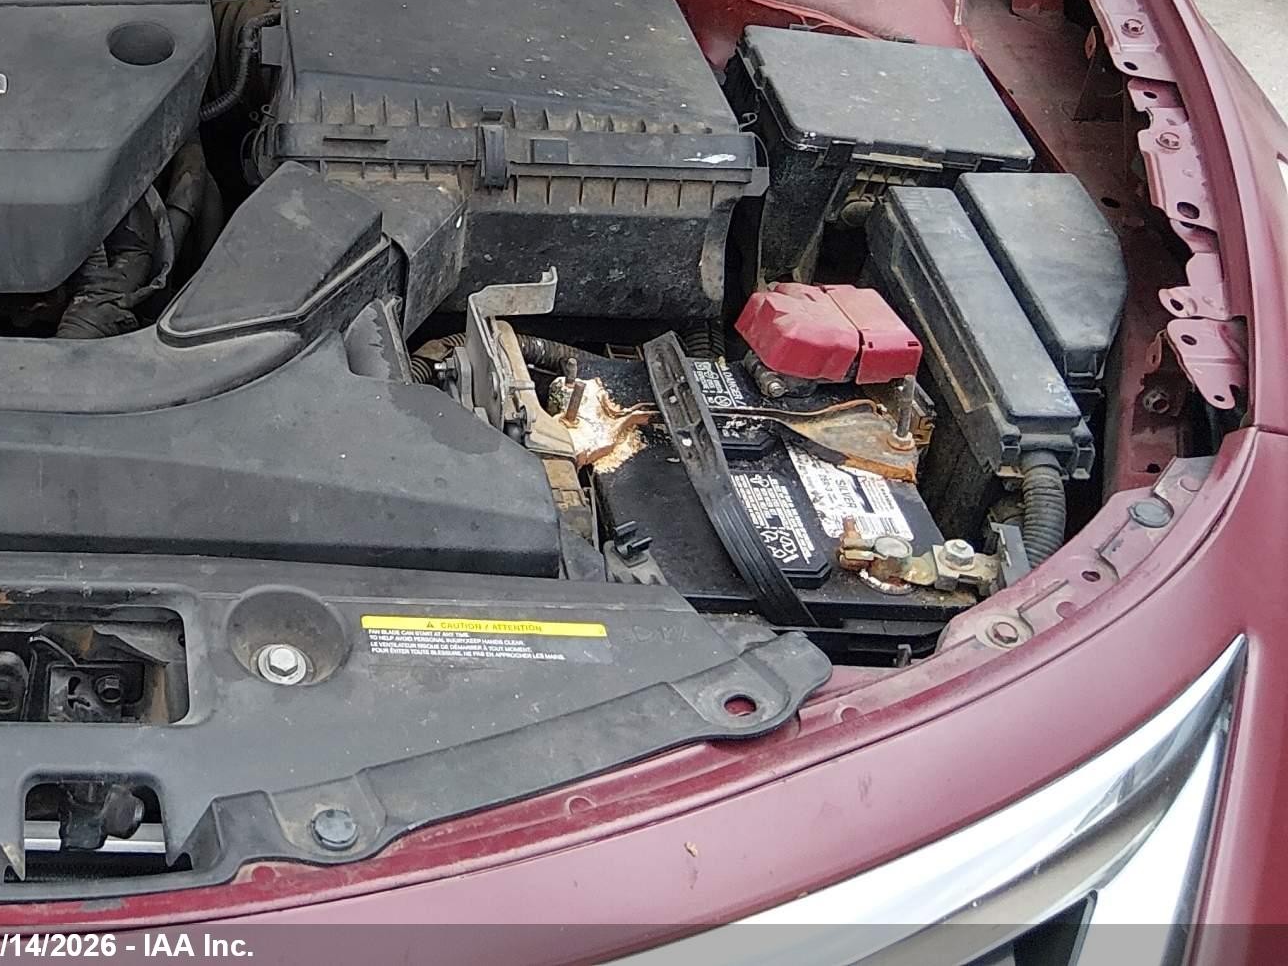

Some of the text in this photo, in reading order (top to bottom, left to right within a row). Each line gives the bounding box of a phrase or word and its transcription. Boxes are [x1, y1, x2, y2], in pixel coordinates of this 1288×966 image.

[835, 479, 858, 509] SILVER
[440, 621, 482, 631] CAUTION
[492, 623, 543, 633] ATTENTION
